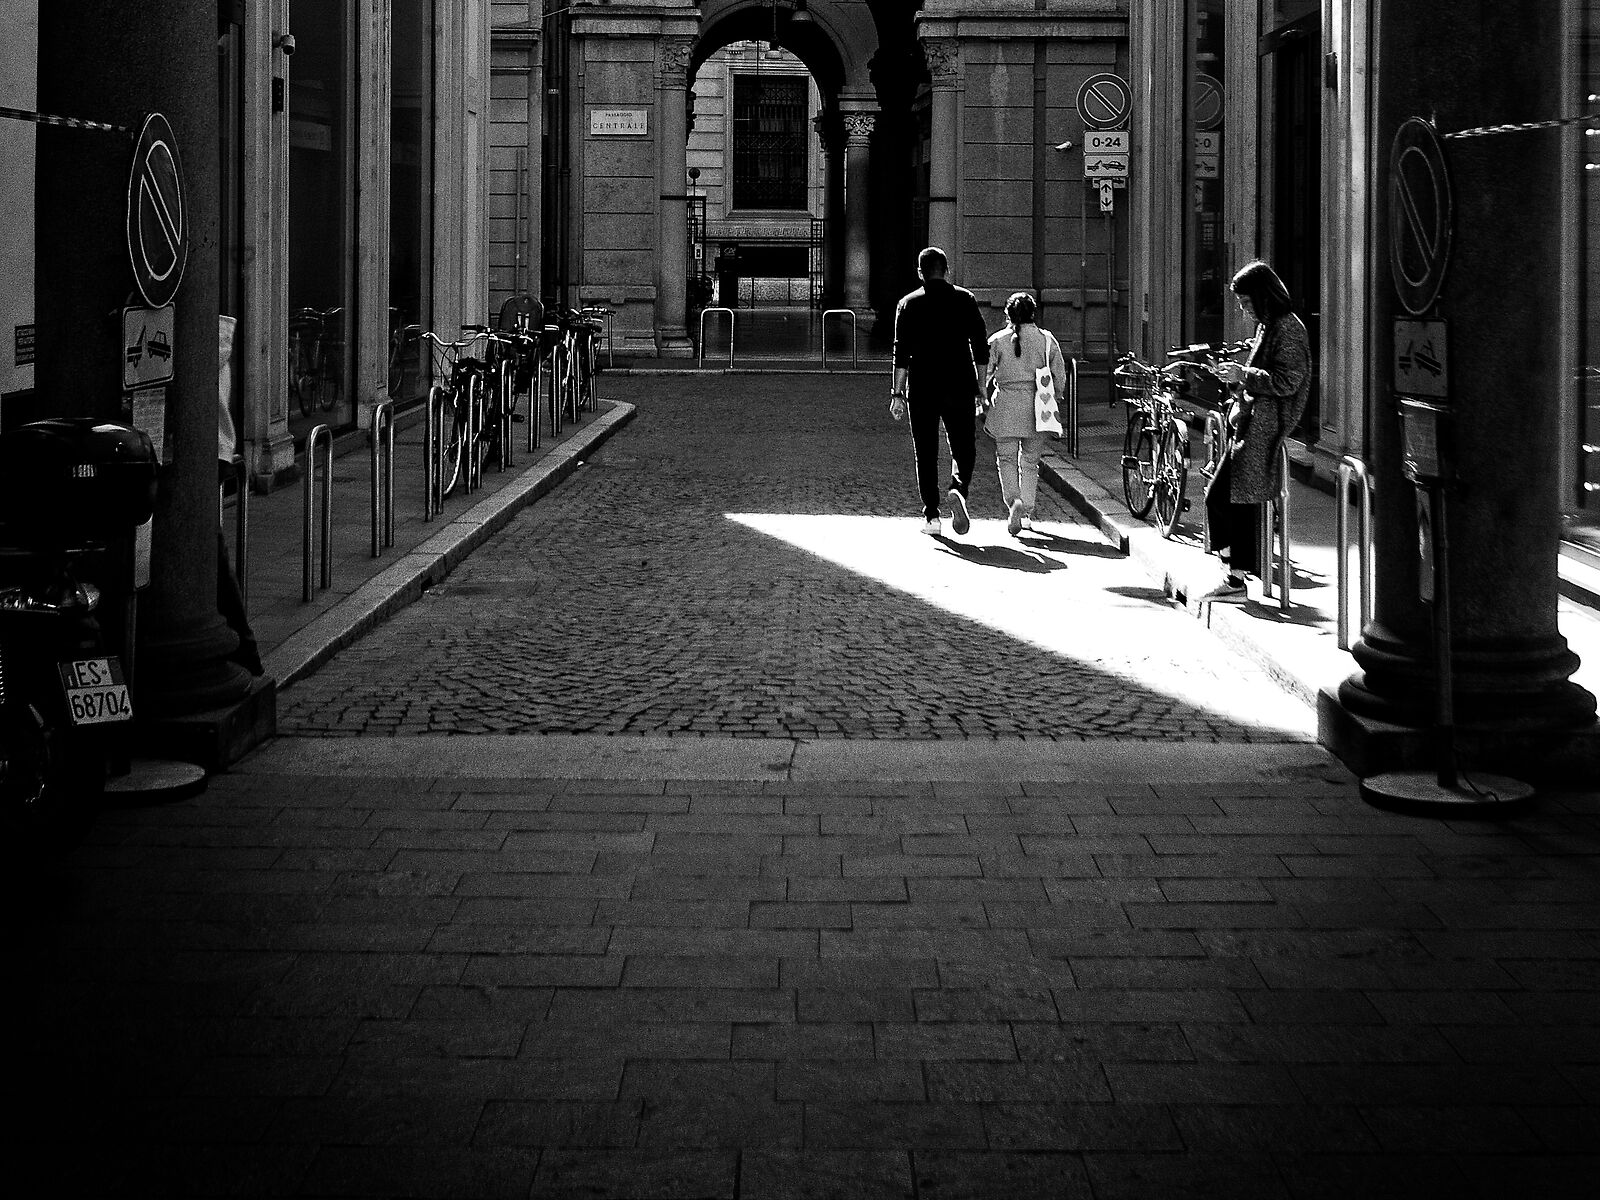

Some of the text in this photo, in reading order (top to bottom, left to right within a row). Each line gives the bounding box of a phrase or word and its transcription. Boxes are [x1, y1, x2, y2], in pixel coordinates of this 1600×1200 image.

[1092, 137, 1121, 148] 0-24
[75, 661, 102, 686] ES
[71, 690, 130, 719] 68704
